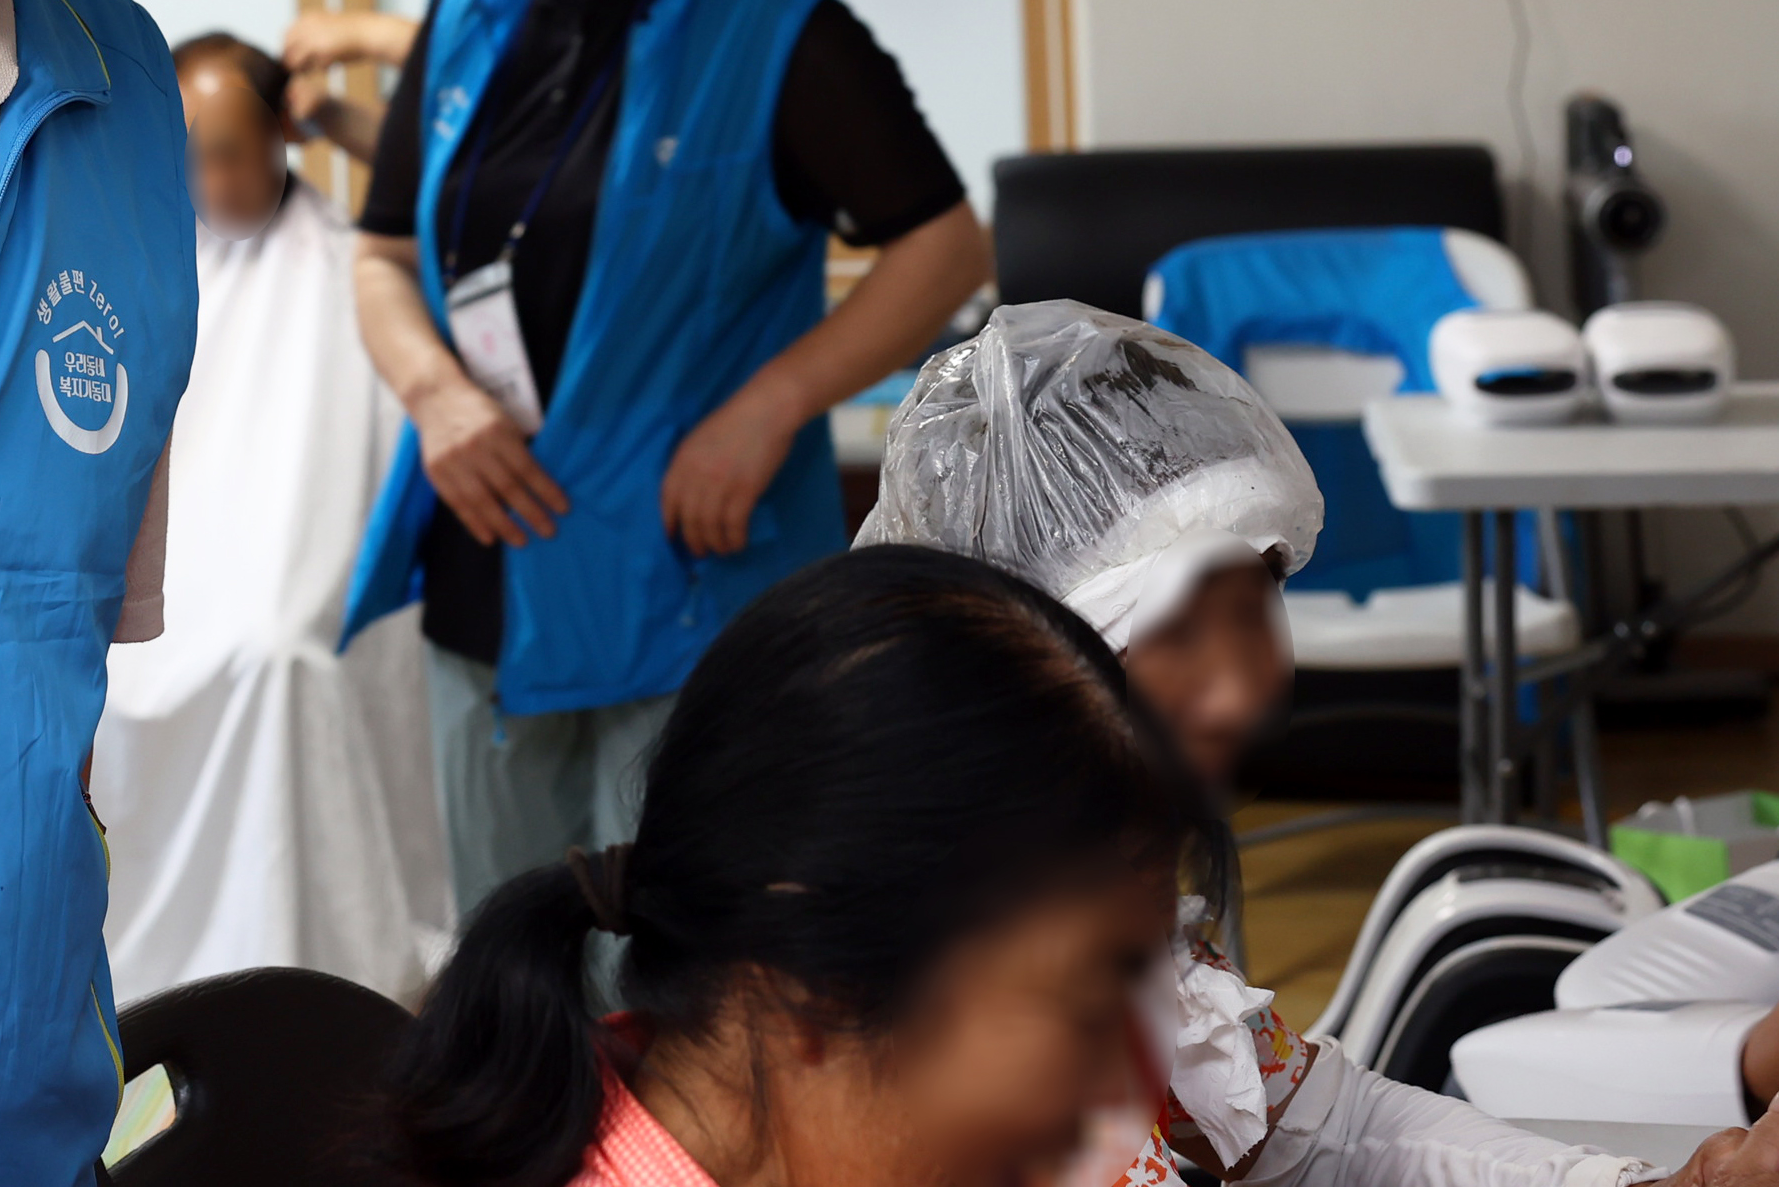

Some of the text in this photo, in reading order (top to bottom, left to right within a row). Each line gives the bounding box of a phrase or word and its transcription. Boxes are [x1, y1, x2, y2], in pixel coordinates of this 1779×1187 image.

[36, 269, 85, 325] 생활불편
[64, 351, 106, 378] 우리동네
[59, 376, 112, 403] 복지기동대
